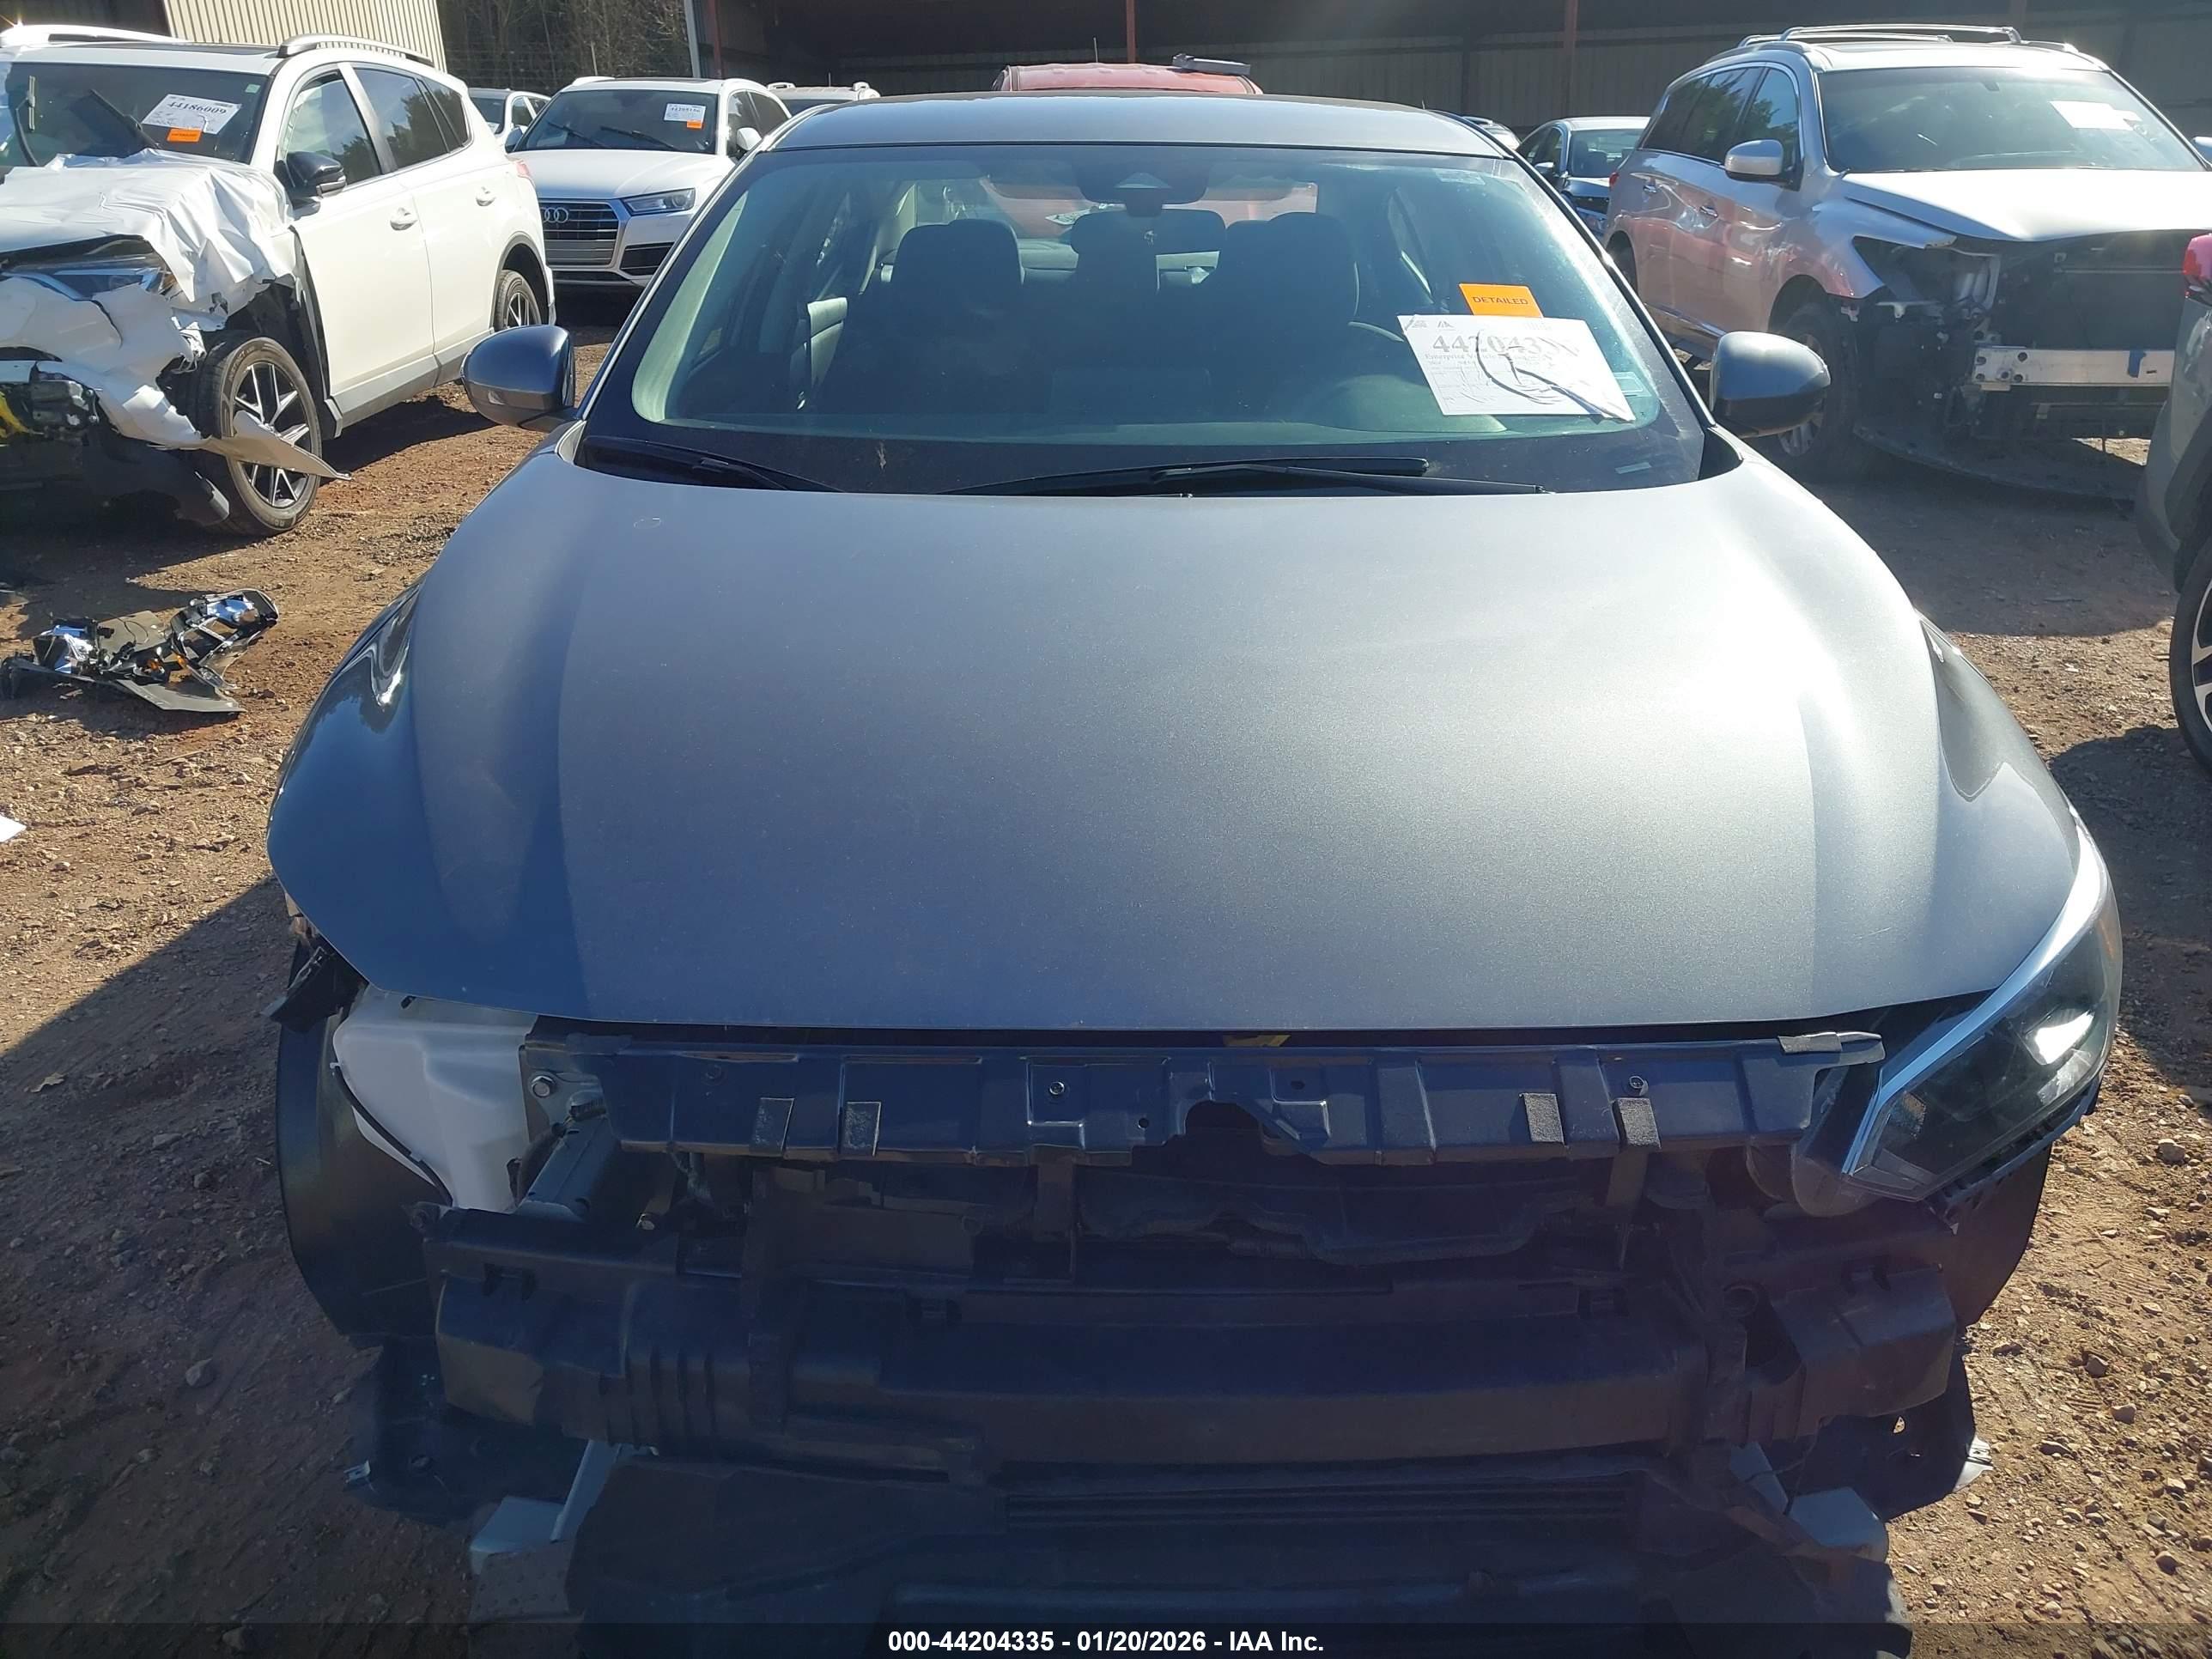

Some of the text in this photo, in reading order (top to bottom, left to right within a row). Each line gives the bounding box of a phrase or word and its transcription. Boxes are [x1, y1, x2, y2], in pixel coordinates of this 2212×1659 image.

[167, 100, 227, 115] 44186009
[1471, 295, 1528, 305] DETAILED
[1432, 334, 1577, 355] 442043
